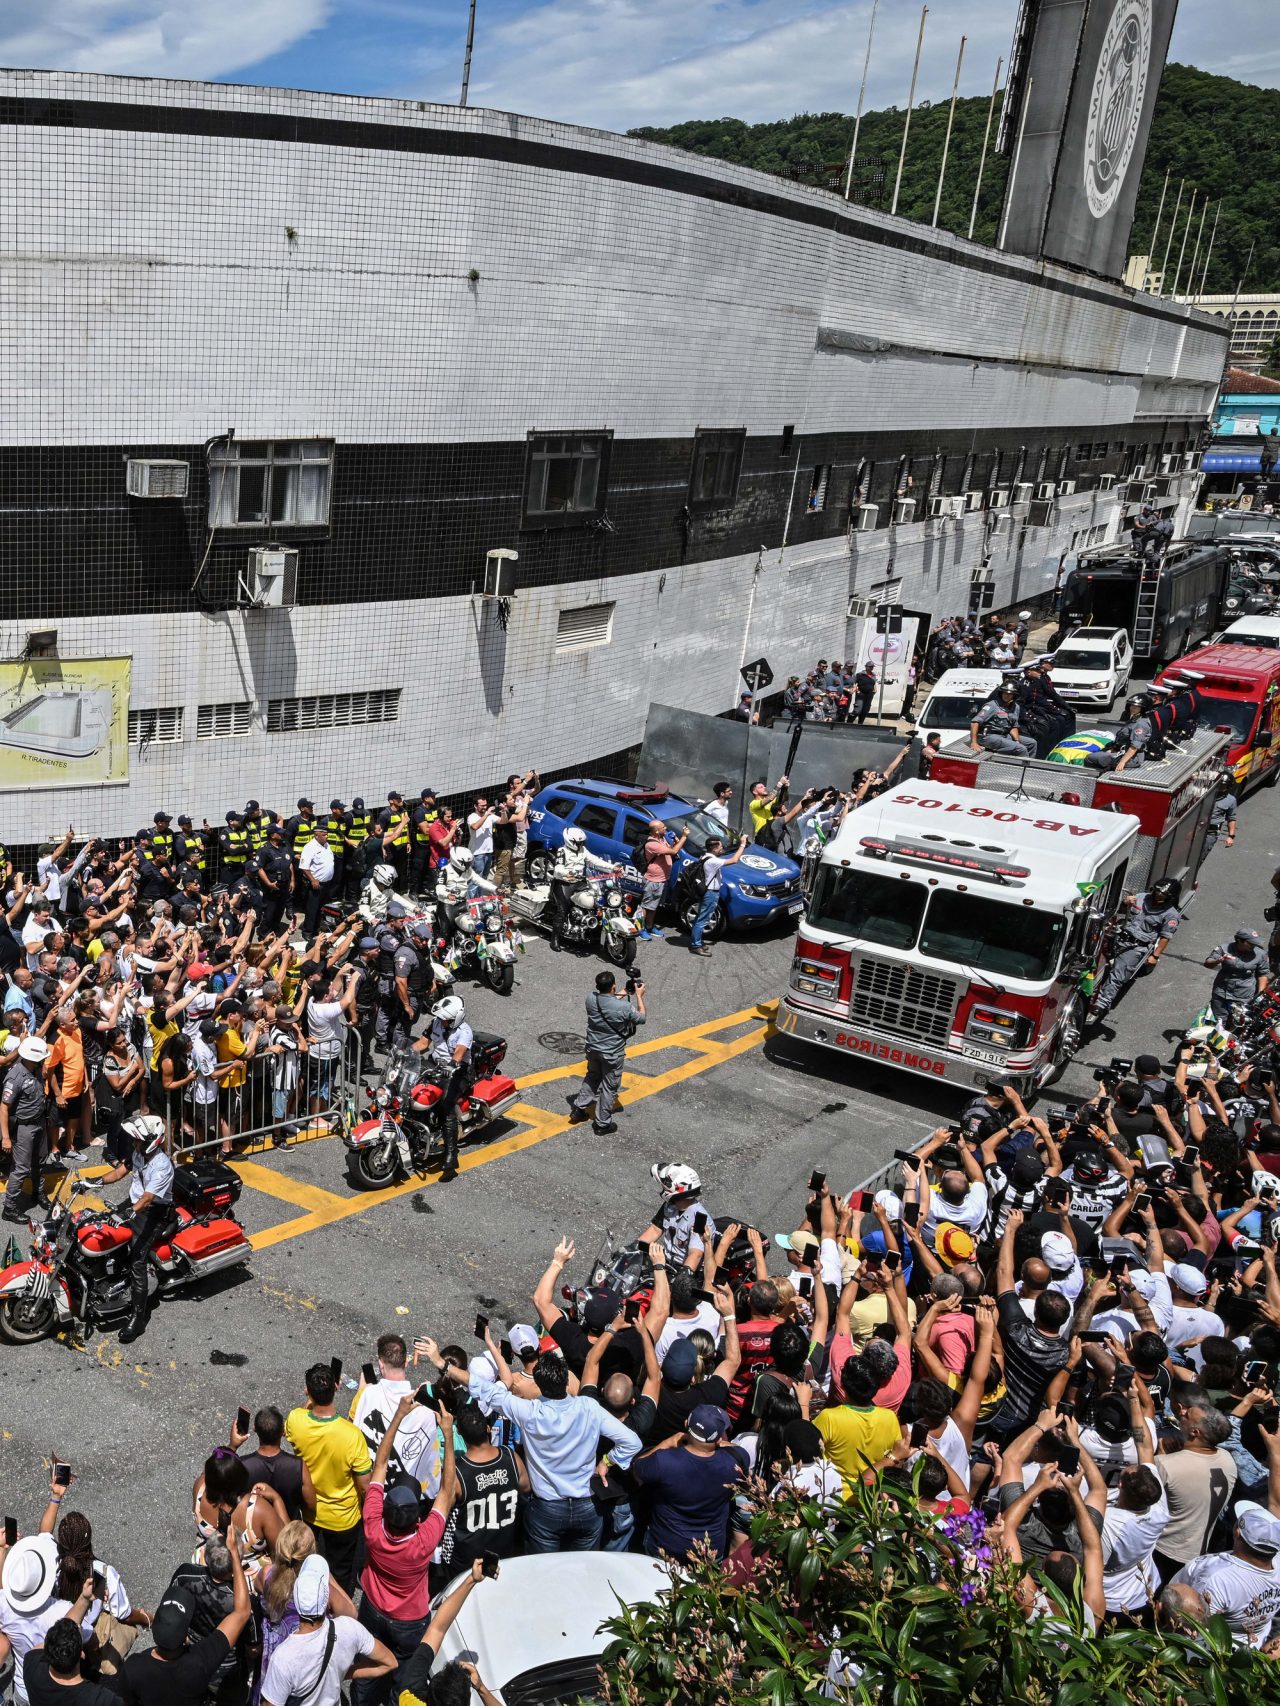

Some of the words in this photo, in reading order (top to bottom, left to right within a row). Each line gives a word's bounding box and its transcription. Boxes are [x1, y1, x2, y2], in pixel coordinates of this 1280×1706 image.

[1091, 28, 1113, 119] MAIOR
[1122, 72, 1145, 168] MUNDO
[891, 794, 1101, 838] AB-06105
[1071, 1203, 1104, 1213] CARLÃO
[466, 1489, 518, 1533] 013
